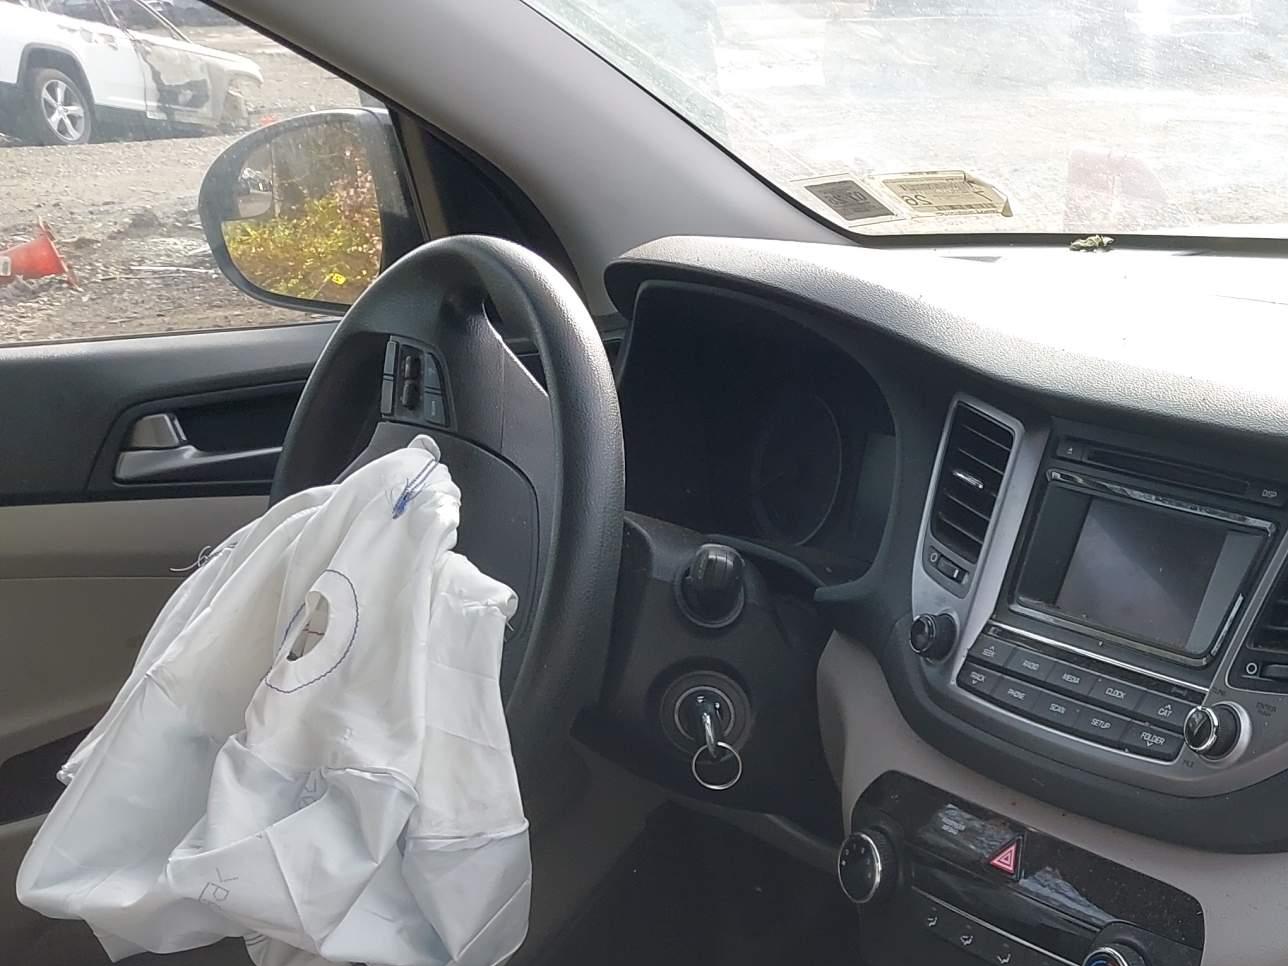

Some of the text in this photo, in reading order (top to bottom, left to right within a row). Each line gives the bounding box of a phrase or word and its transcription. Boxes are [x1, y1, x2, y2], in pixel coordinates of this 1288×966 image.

[1061, 673, 1080, 684] MEDIA
[1105, 687, 1127, 699] CLOCK
[1049, 703, 1066, 714] SCAN
[1158, 707, 1173, 717] CAT
[1090, 718, 1111, 729] SETUP
[1140, 731, 1166, 745] FOLDER
